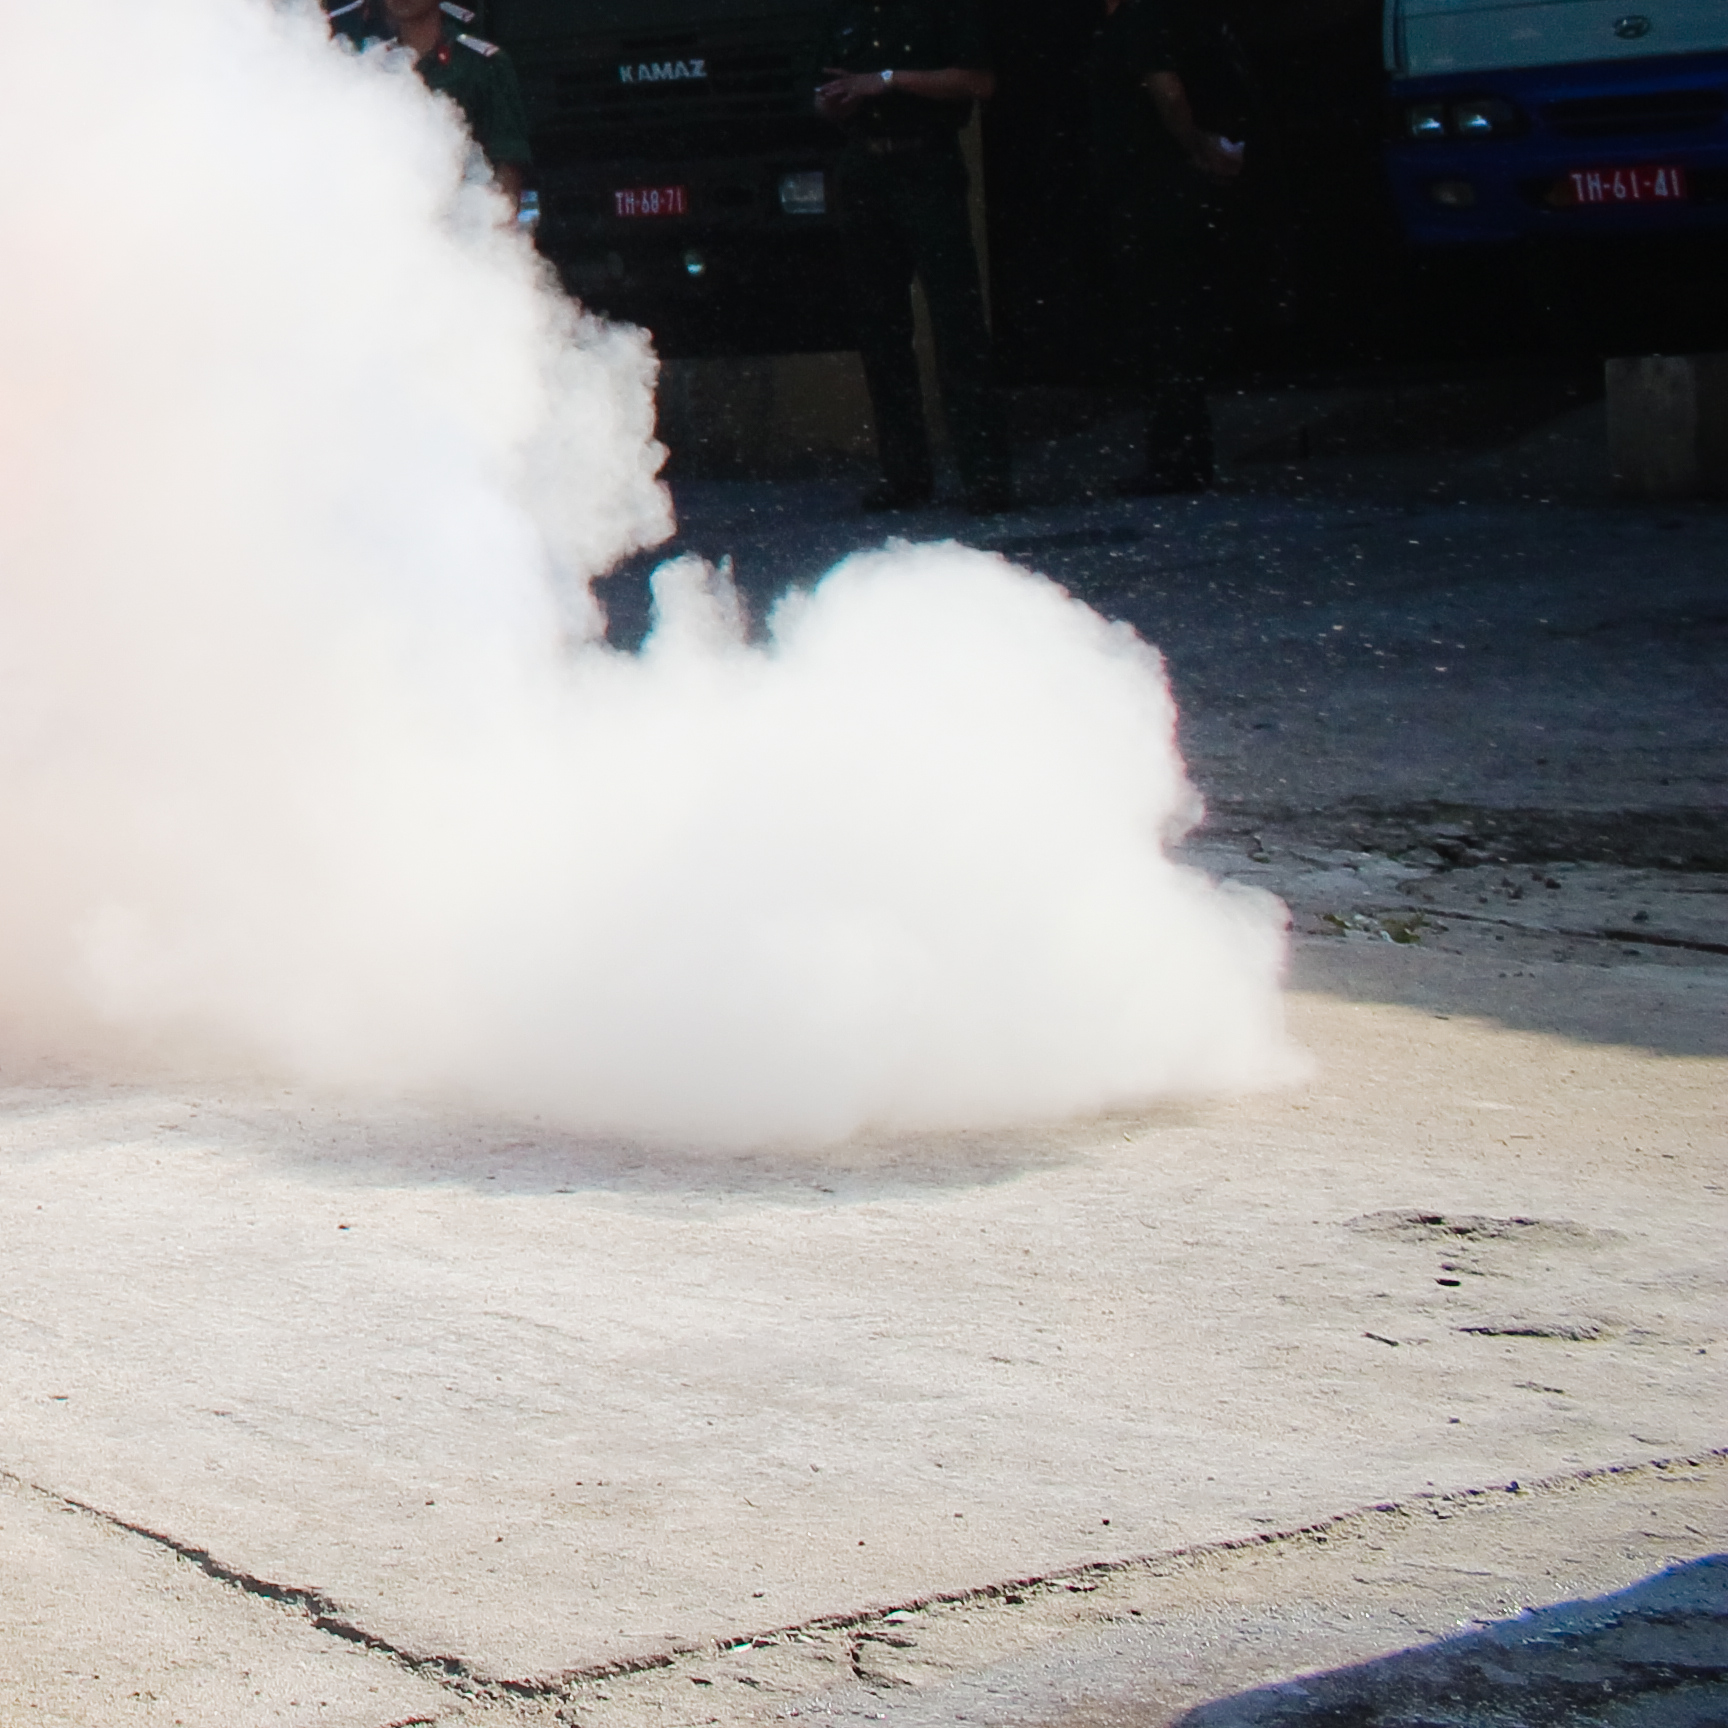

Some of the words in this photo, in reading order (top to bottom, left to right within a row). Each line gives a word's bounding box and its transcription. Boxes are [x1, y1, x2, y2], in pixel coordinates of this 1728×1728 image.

[618, 58, 708, 84] KAMAZ
[1570, 168, 1681, 202] TH-61-41
[614, 186, 684, 216] TH-68-71
